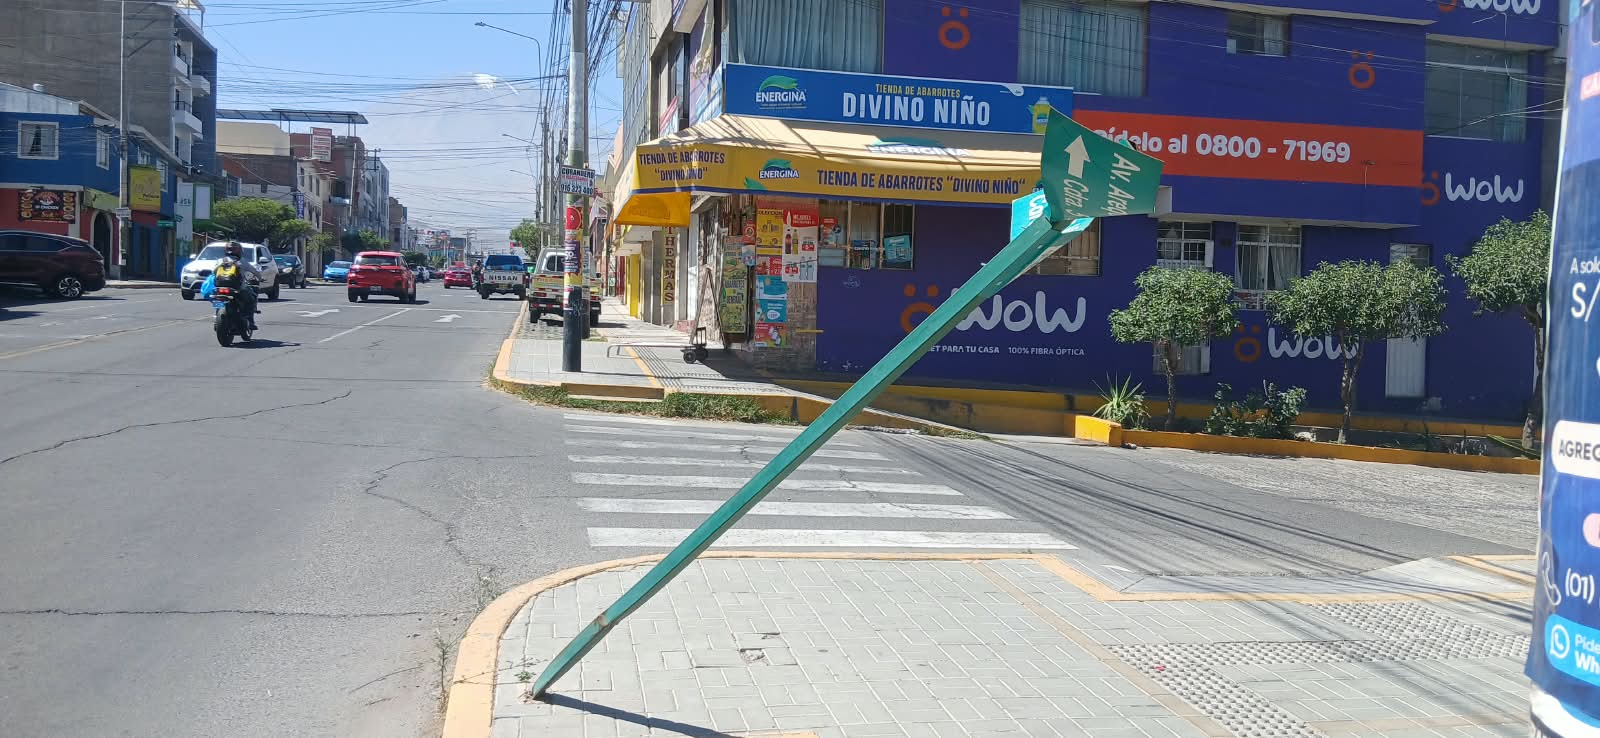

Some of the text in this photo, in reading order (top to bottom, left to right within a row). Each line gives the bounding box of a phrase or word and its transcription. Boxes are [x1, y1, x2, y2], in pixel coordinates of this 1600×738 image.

[755, 91, 806, 102] ENERGINA
[875, 83, 960, 98] TIENDA DE ABARROTES
[843, 92, 990, 126] DIVINO NIÑO
[1168, 134, 1187, 154] al
[1196, 133, 1261, 158] 0800
[1282, 139, 1351, 163] 71969
[639, 151, 725, 166] TIENDA DE ABARROTES
[1110, 152, 1141, 183] Av.
[759, 170, 800, 179] ENERGINA
[817, 169, 858, 187] TIENDA
[860, 172, 875, 188] DE
[877, 173, 943, 192] ABARROTES
[1101, 183, 1135, 215] Areq
[1570, 257, 1579, 274] A
[942, 345, 964, 353] PARA
[978, 346, 1000, 354] CASA
[1031, 347, 1054, 355] FIBRA
[1055, 347, 1085, 356] ÓPTICA
[1565, 567, 1595, 604] (01)
